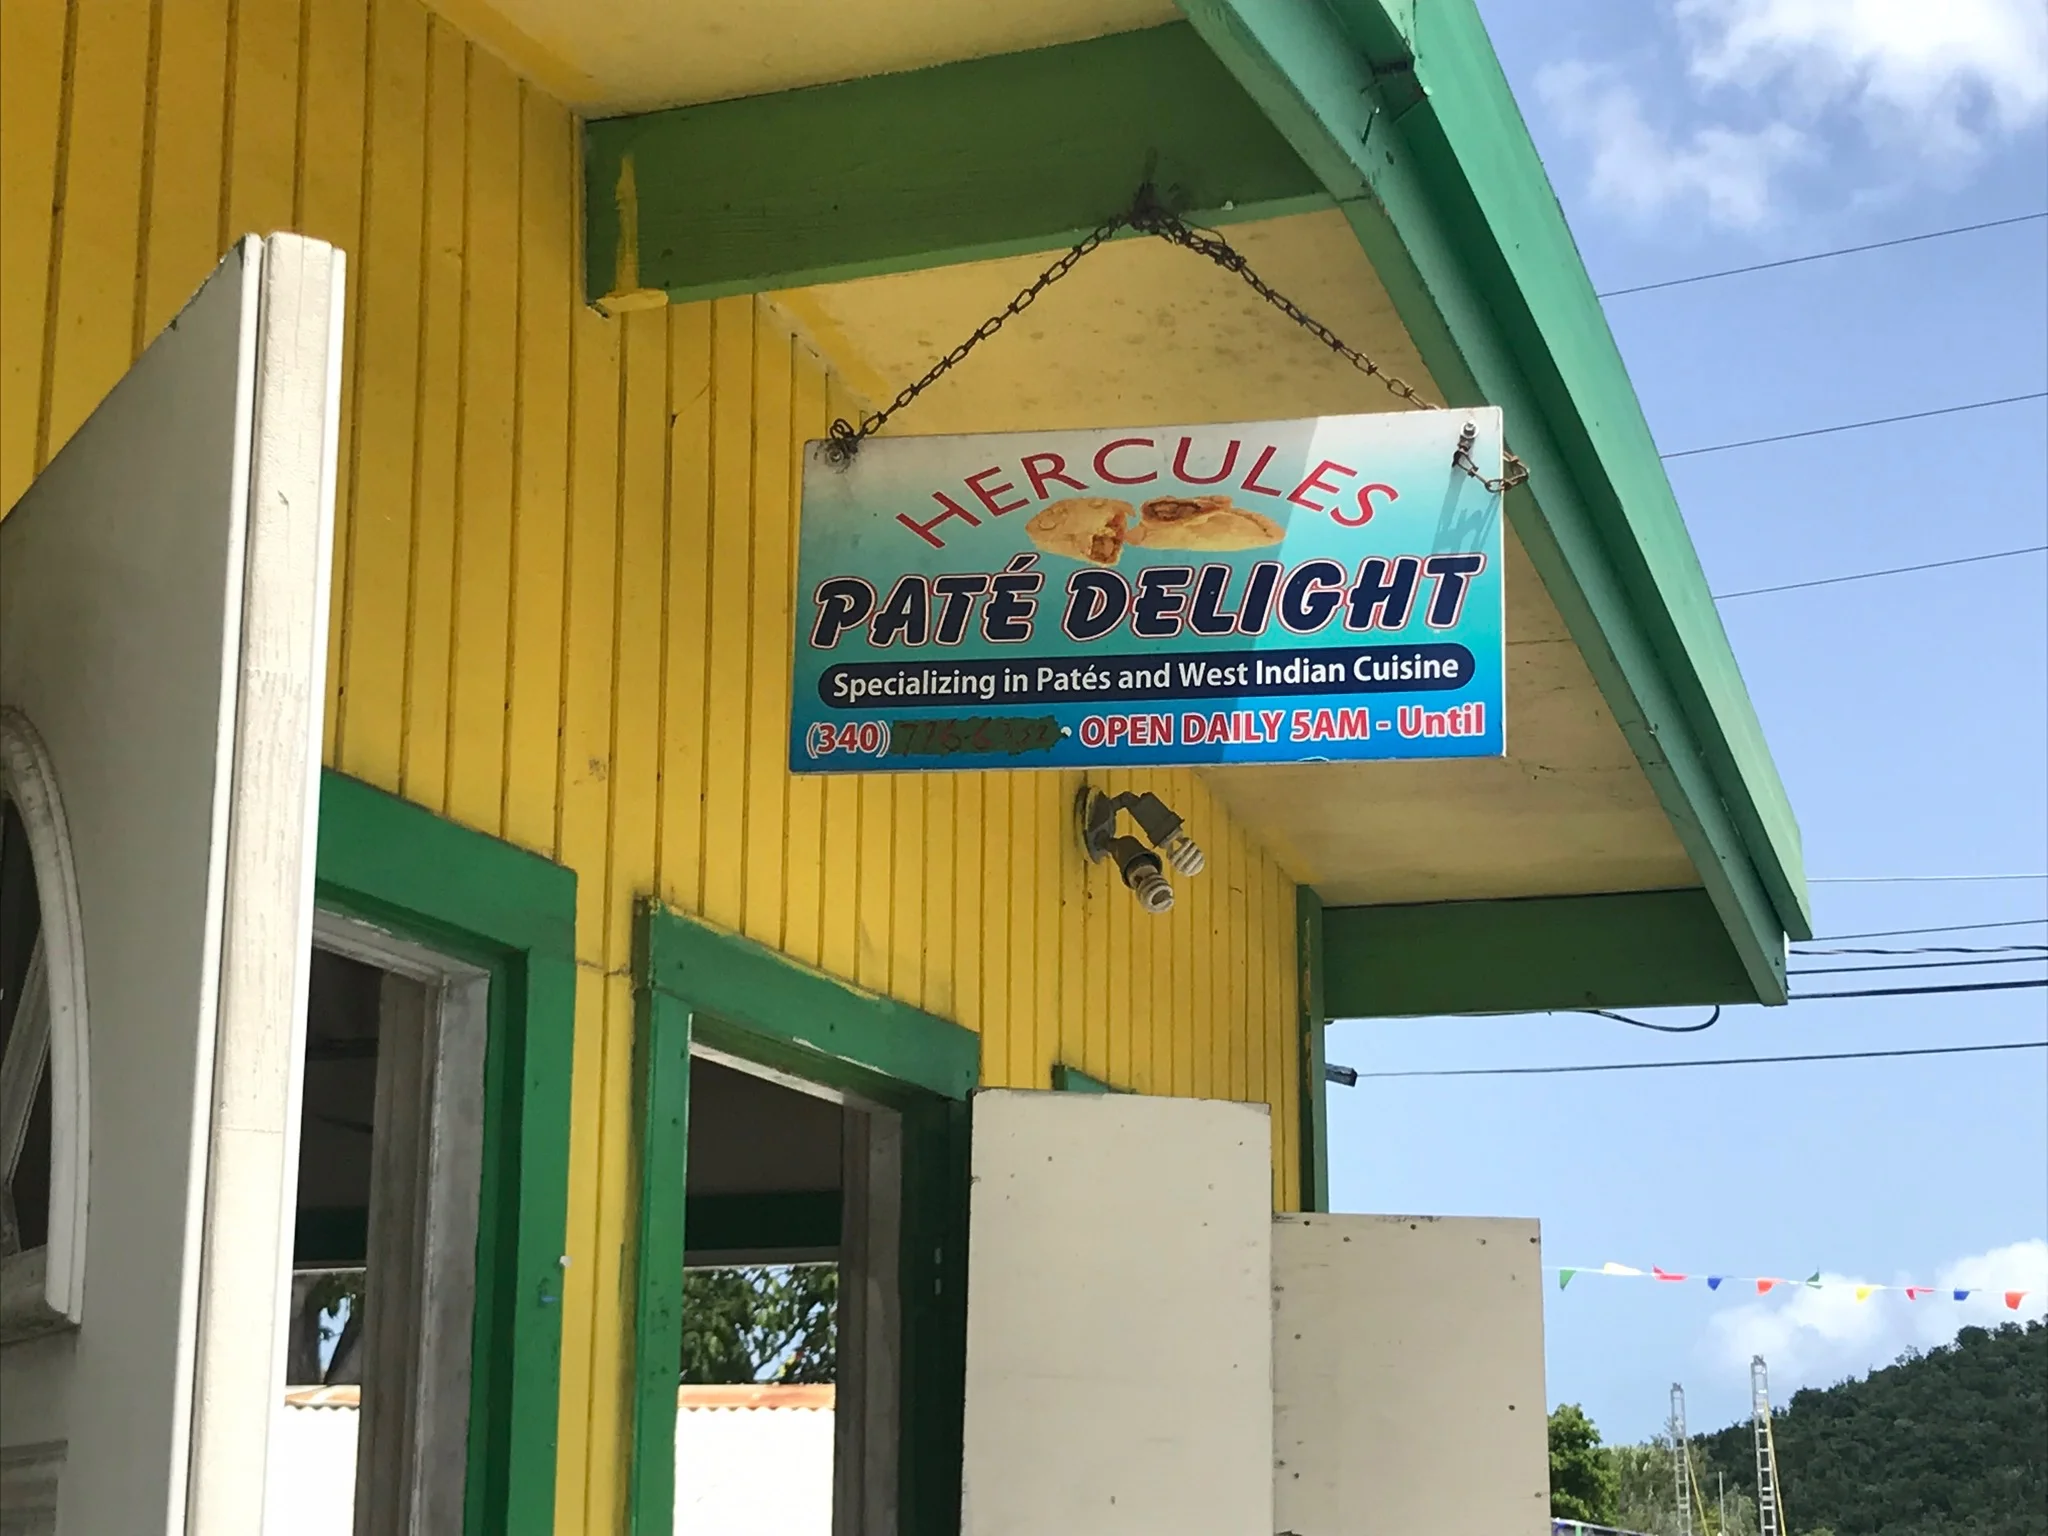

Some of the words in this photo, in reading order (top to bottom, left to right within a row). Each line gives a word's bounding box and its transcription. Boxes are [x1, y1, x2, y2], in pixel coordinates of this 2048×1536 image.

[895, 436, 1400, 549] HERCULES
[809, 552, 1045, 650] PATÉ
[1061, 552, 1488, 643] DELIGHT
[833, 668, 996, 703] Specializing
[1003, 667, 1029, 693] in
[1036, 664, 1112, 692] Patés
[1117, 662, 1171, 689] and
[1178, 661, 1249, 688] West
[1256, 657, 1346, 686] Indian
[1353, 653, 1459, 682] Cuisine
[806, 720, 891, 759] (340)
[1079, 713, 1174, 749] OPEN
[1181, 708, 1286, 745] DAILY
[1290, 706, 1371, 744] 5AM
[1396, 701, 1486, 739] Until
